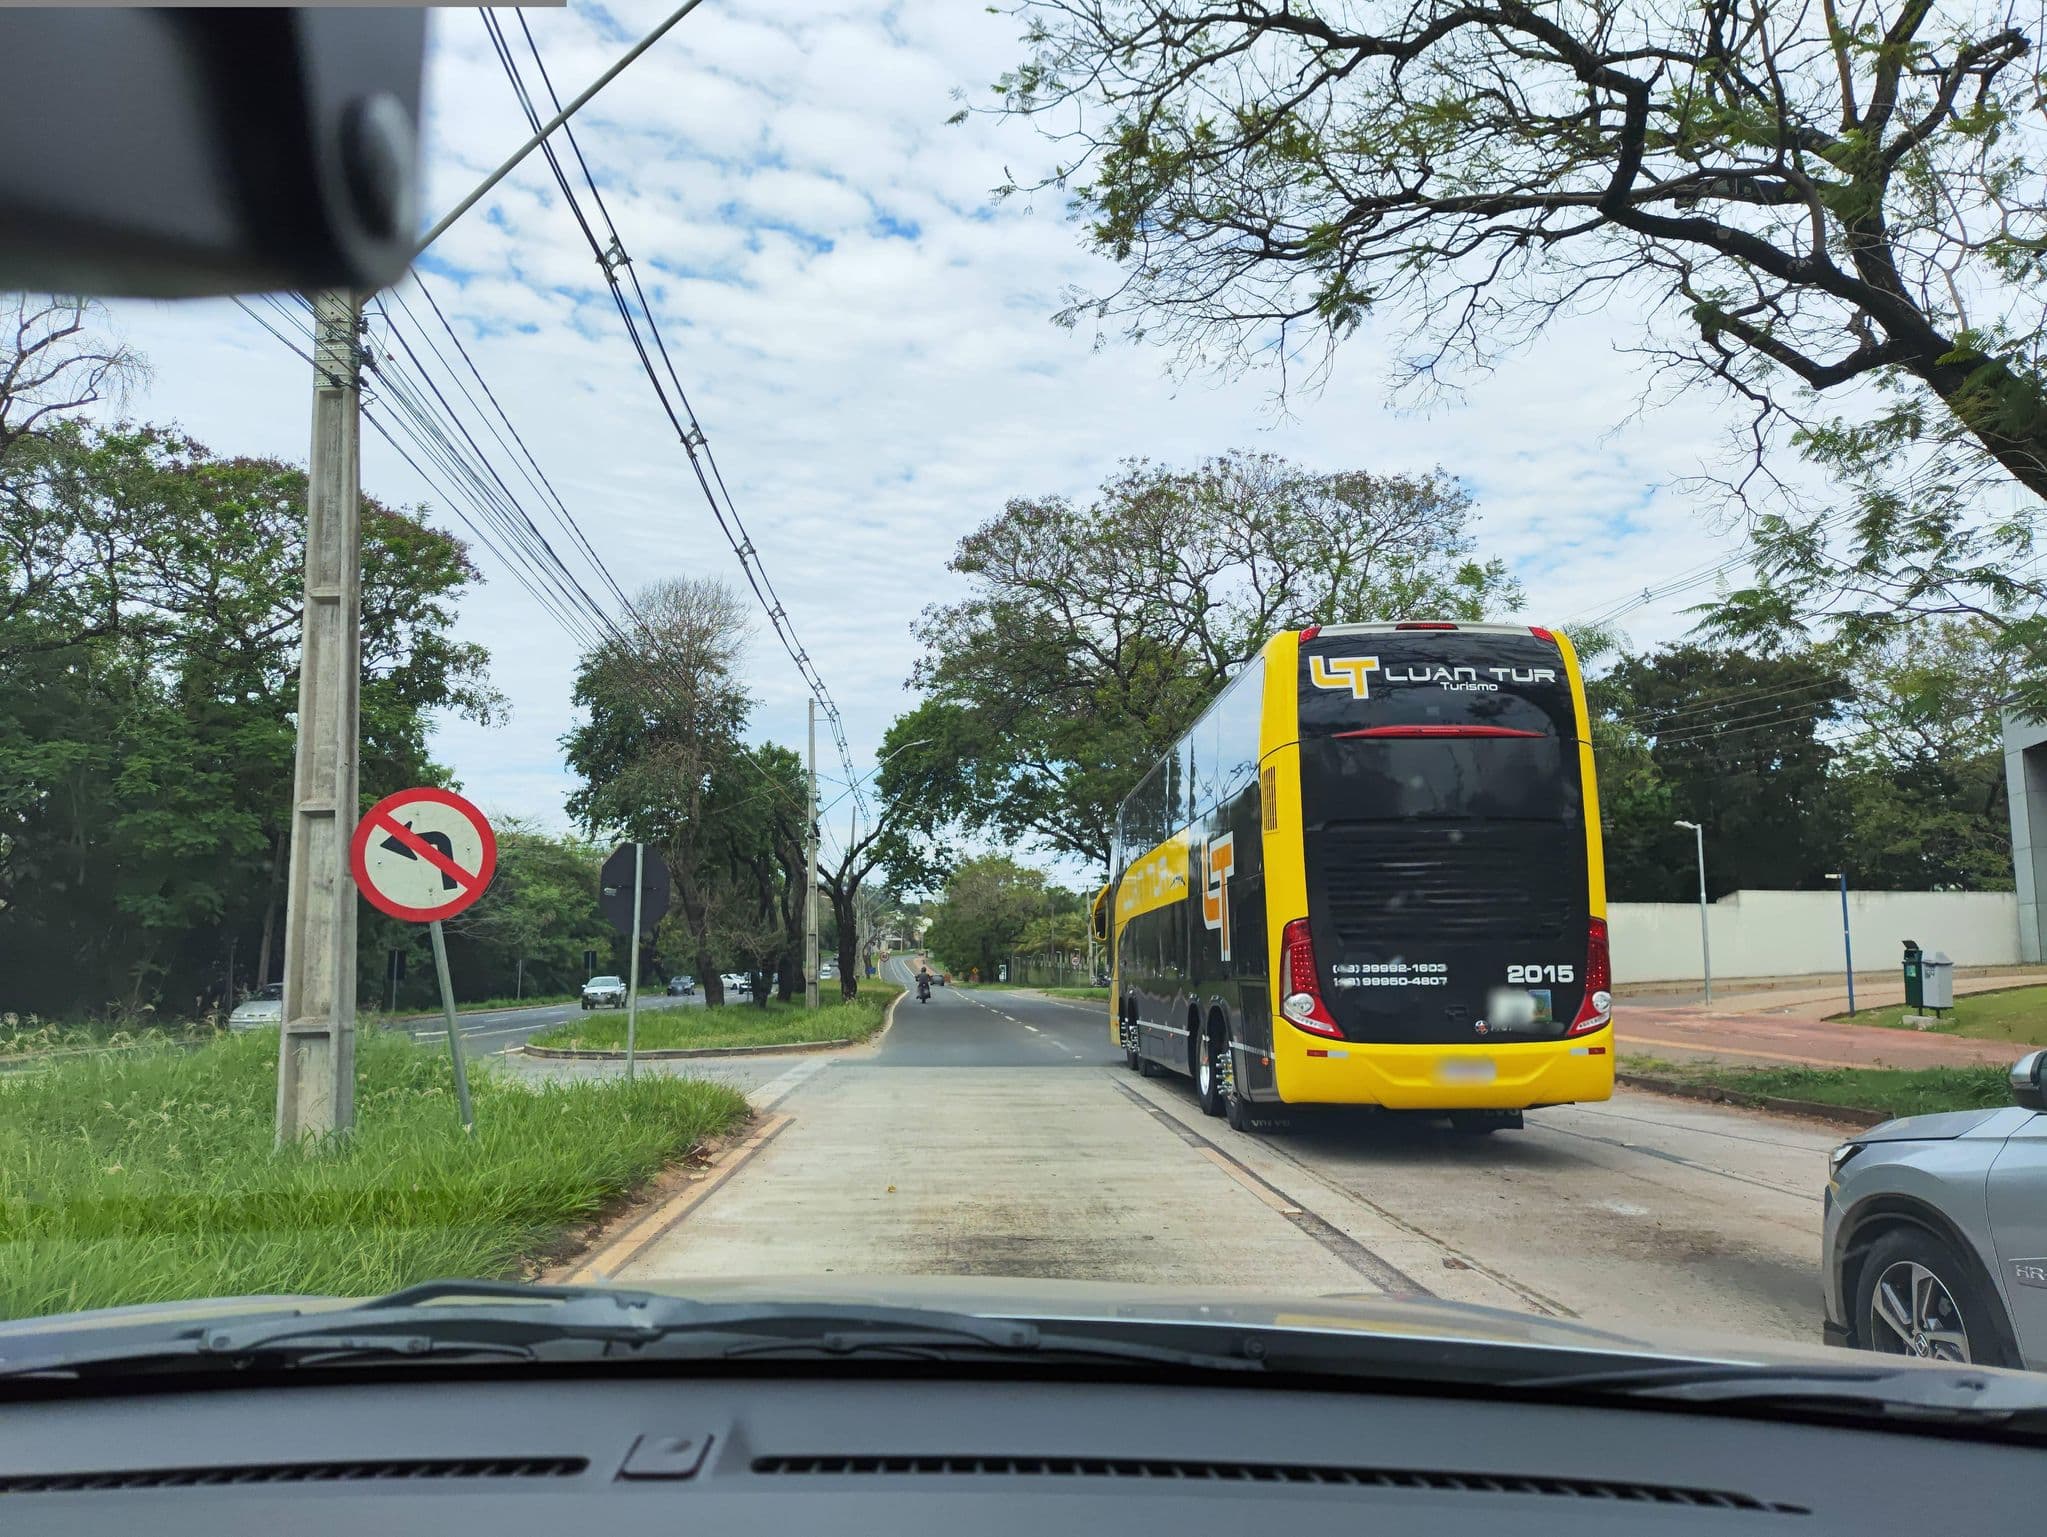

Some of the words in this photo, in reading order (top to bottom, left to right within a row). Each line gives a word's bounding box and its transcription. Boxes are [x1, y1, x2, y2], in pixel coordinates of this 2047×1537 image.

[1385, 667, 1476, 681] LUAN
[1489, 667, 1556, 683] TUR
[1440, 681, 1498, 691] Turismo
[1507, 964, 1575, 983] 2015
